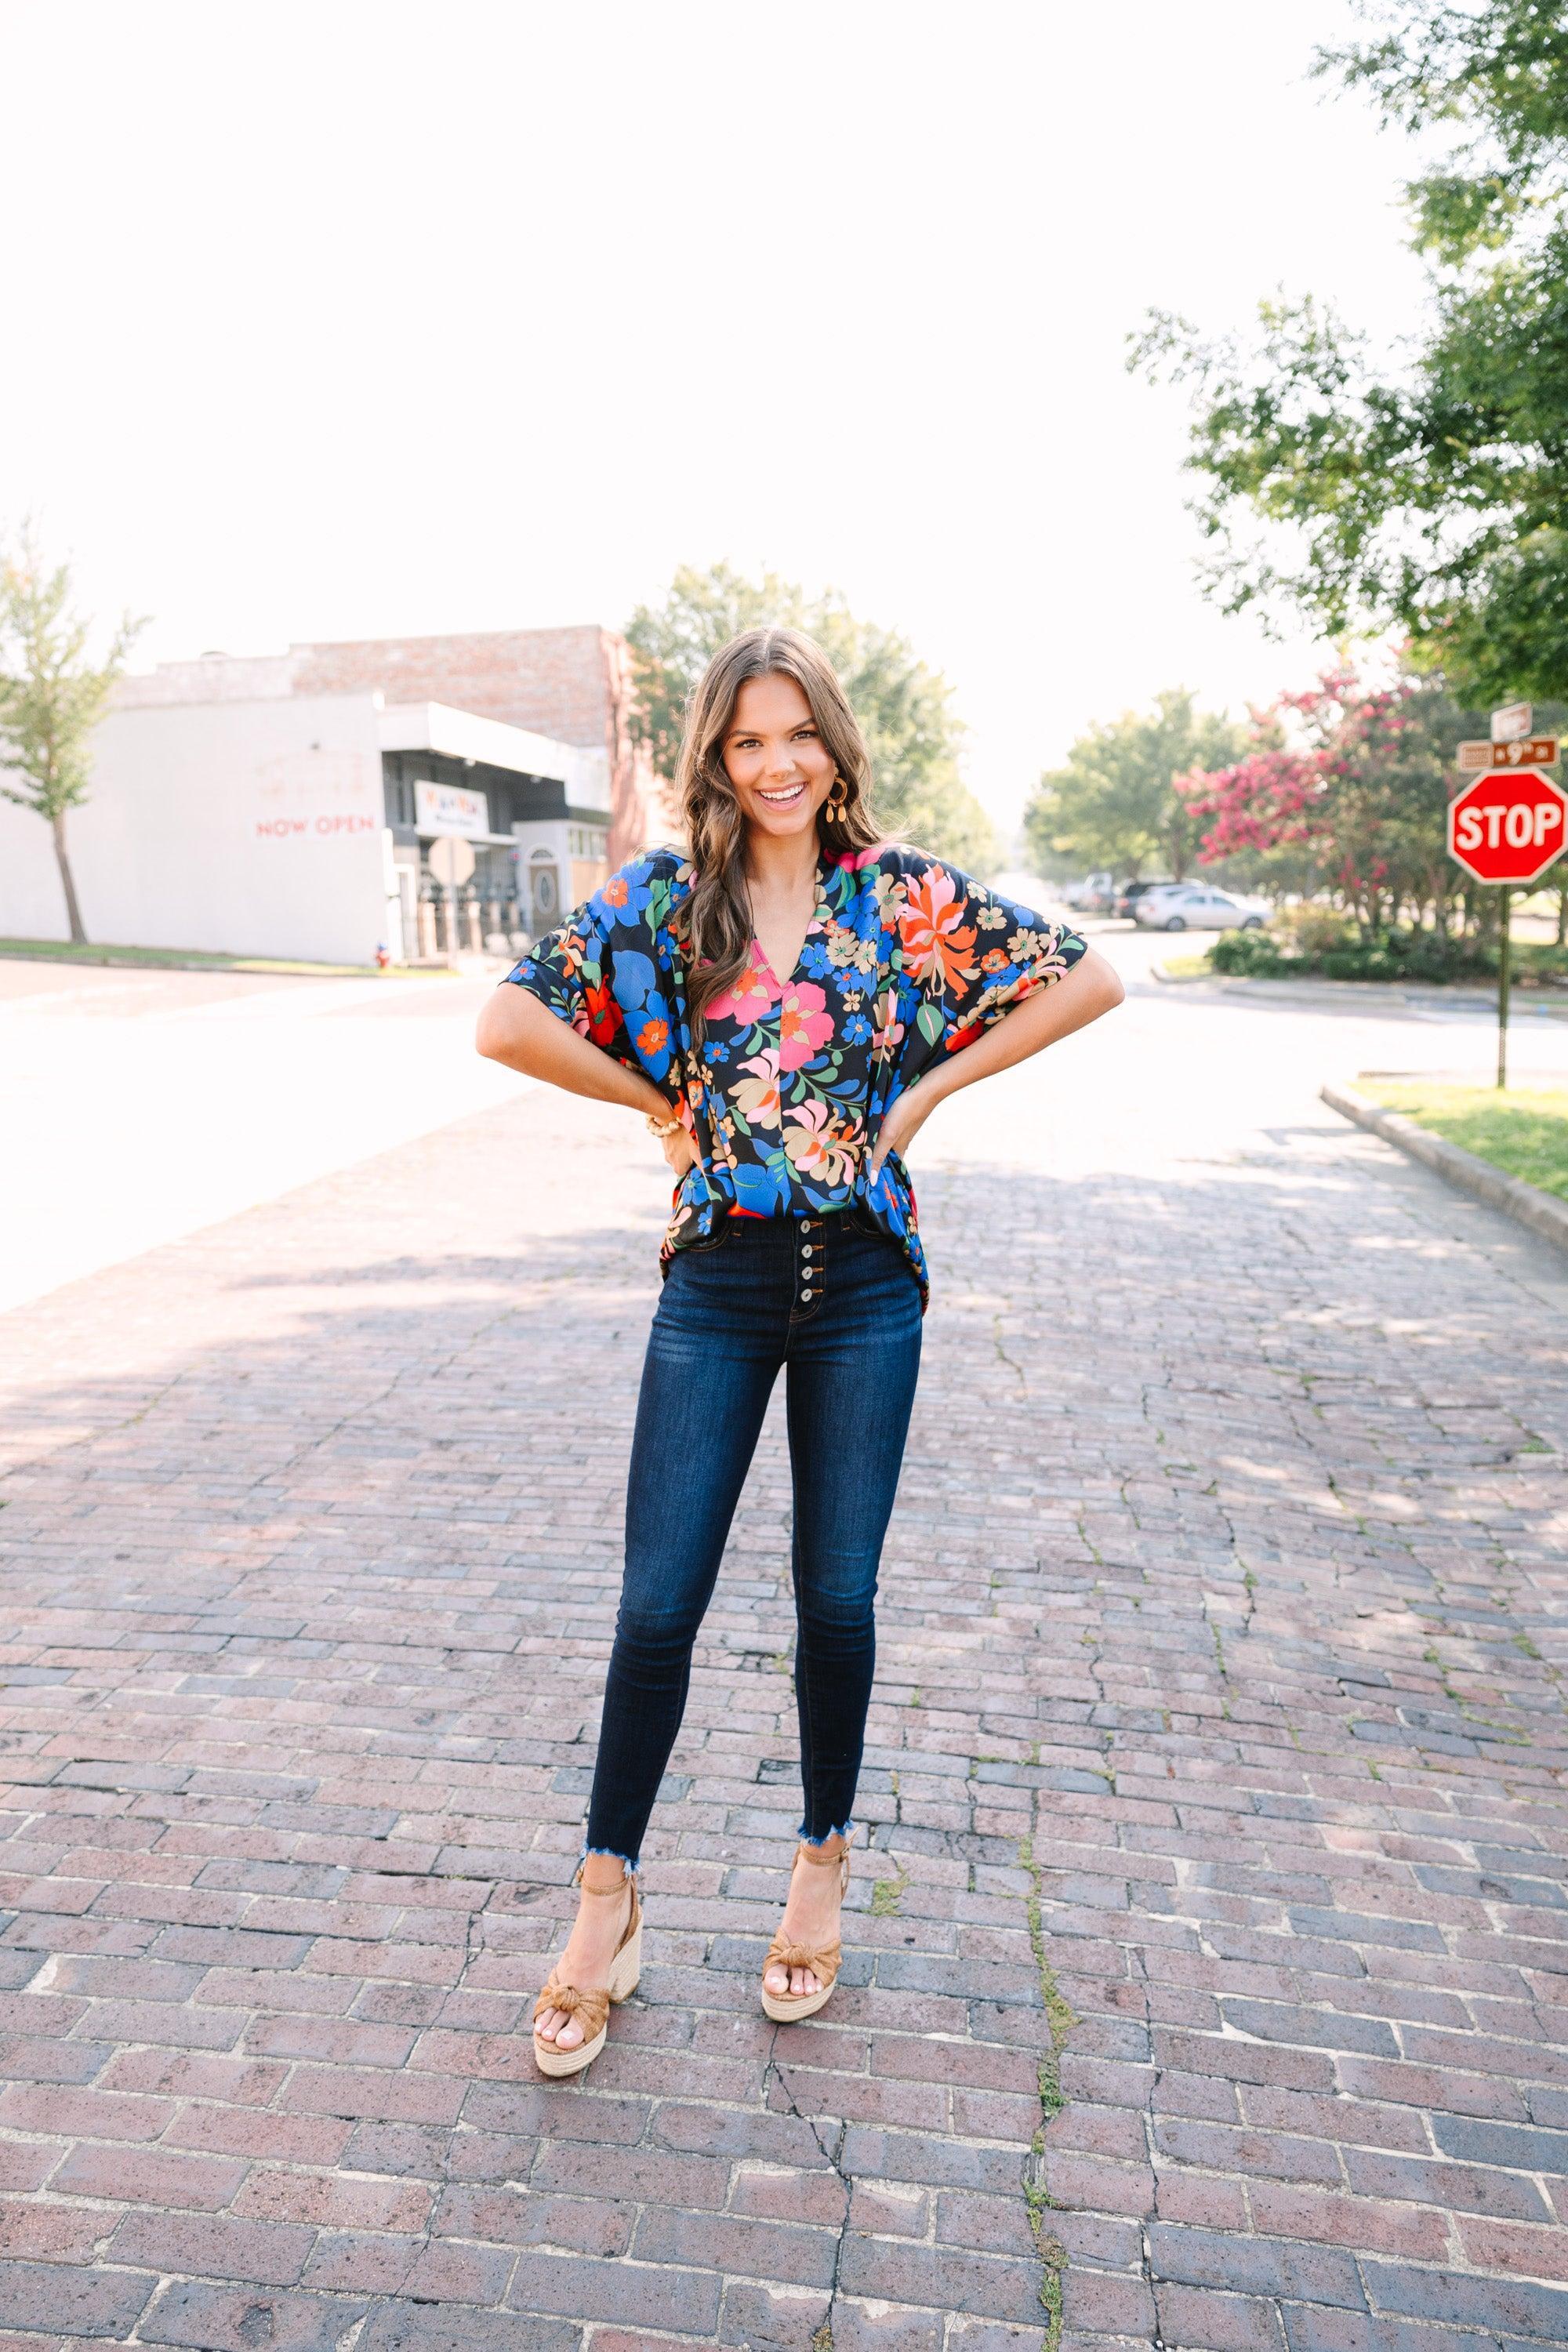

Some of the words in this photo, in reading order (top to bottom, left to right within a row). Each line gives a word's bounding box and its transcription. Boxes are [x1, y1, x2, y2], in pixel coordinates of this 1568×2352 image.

[256, 818, 307, 838] NOW
[315, 815, 375, 835] OPEN
[1456, 803, 1562, 851] STOP
